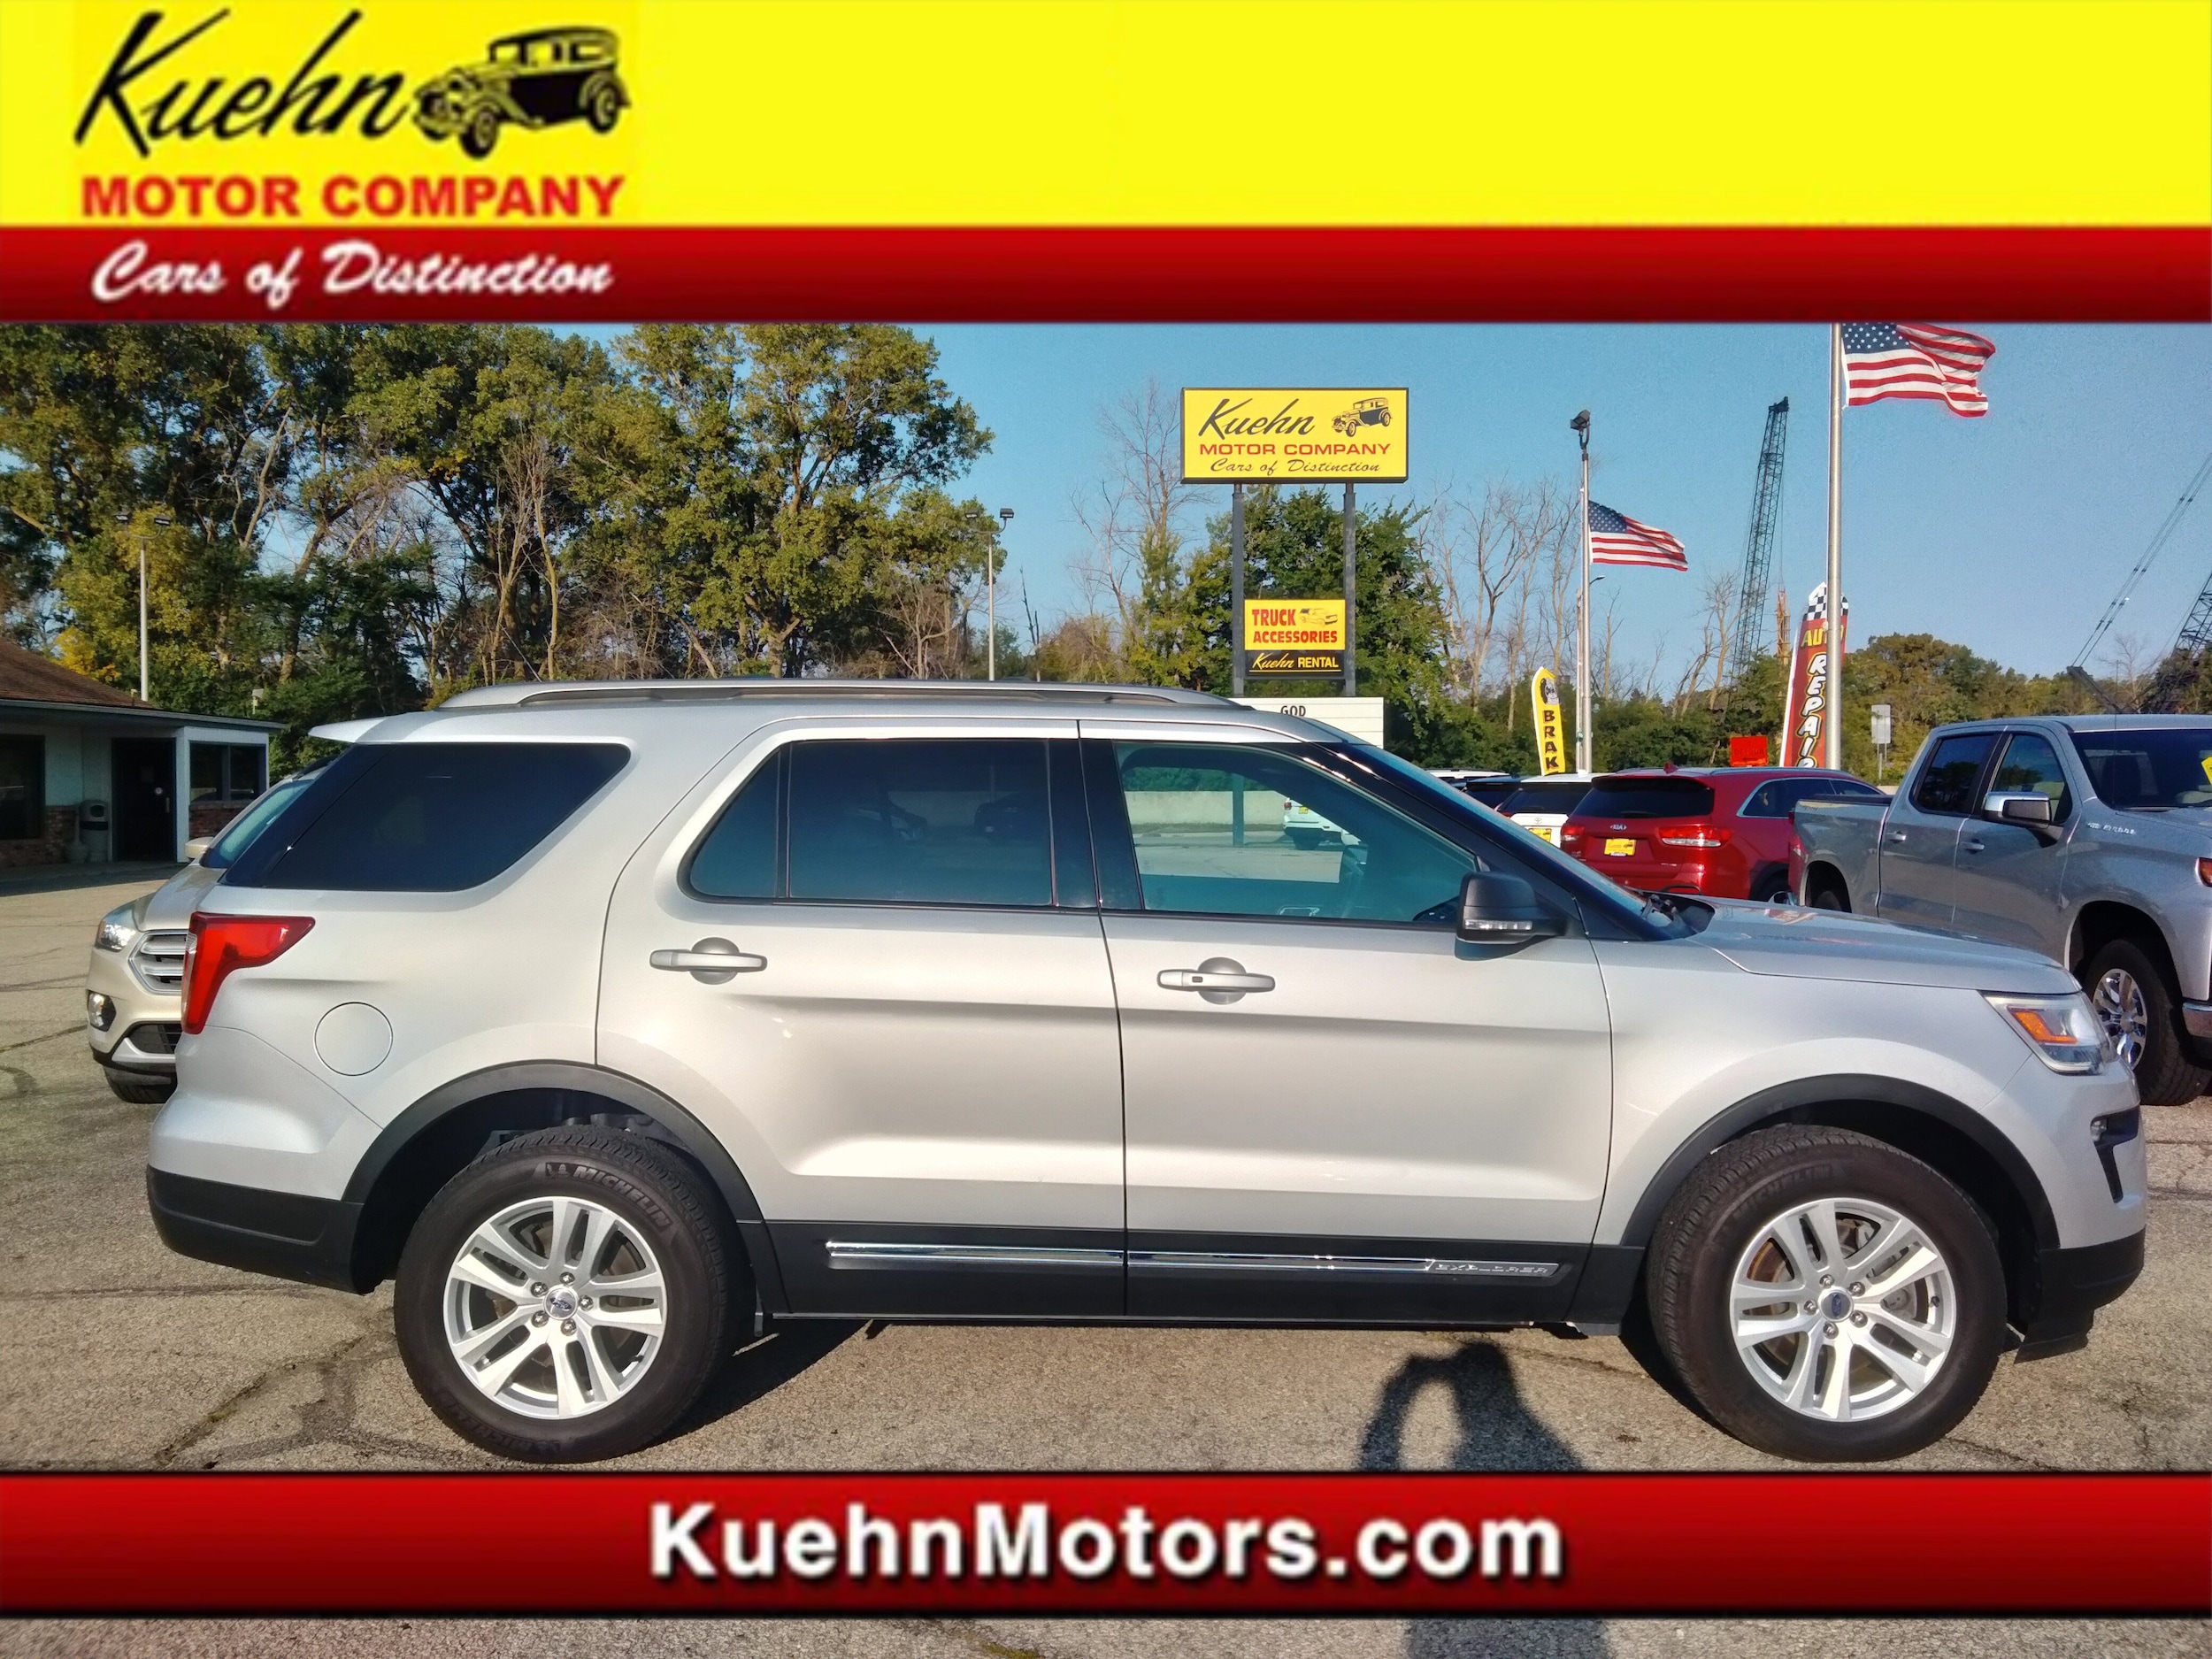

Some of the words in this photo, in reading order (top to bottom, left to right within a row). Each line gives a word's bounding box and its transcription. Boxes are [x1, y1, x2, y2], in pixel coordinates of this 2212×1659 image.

[1198, 398, 1315, 440] Kuehn
[1200, 443, 1276, 455] MOTOR
[1283, 443, 1391, 455] COMPANY
[1210, 457, 1254, 472] Cars
[1259, 460, 1278, 475] of
[1286, 458, 1380, 472] Distinction
[1251, 609, 1296, 626] TRUCK
[1253, 630, 1338, 643] ACCESSORIES
[1800, 624, 1845, 647] AU
[1251, 652, 1295, 670] Kuehn
[1297, 657, 1340, 668] RENTAL
[1280, 705, 1306, 717] GOD
[1542, 710, 1559, 775] BRAK
[572, 1165, 672, 1228] MICHELIN
